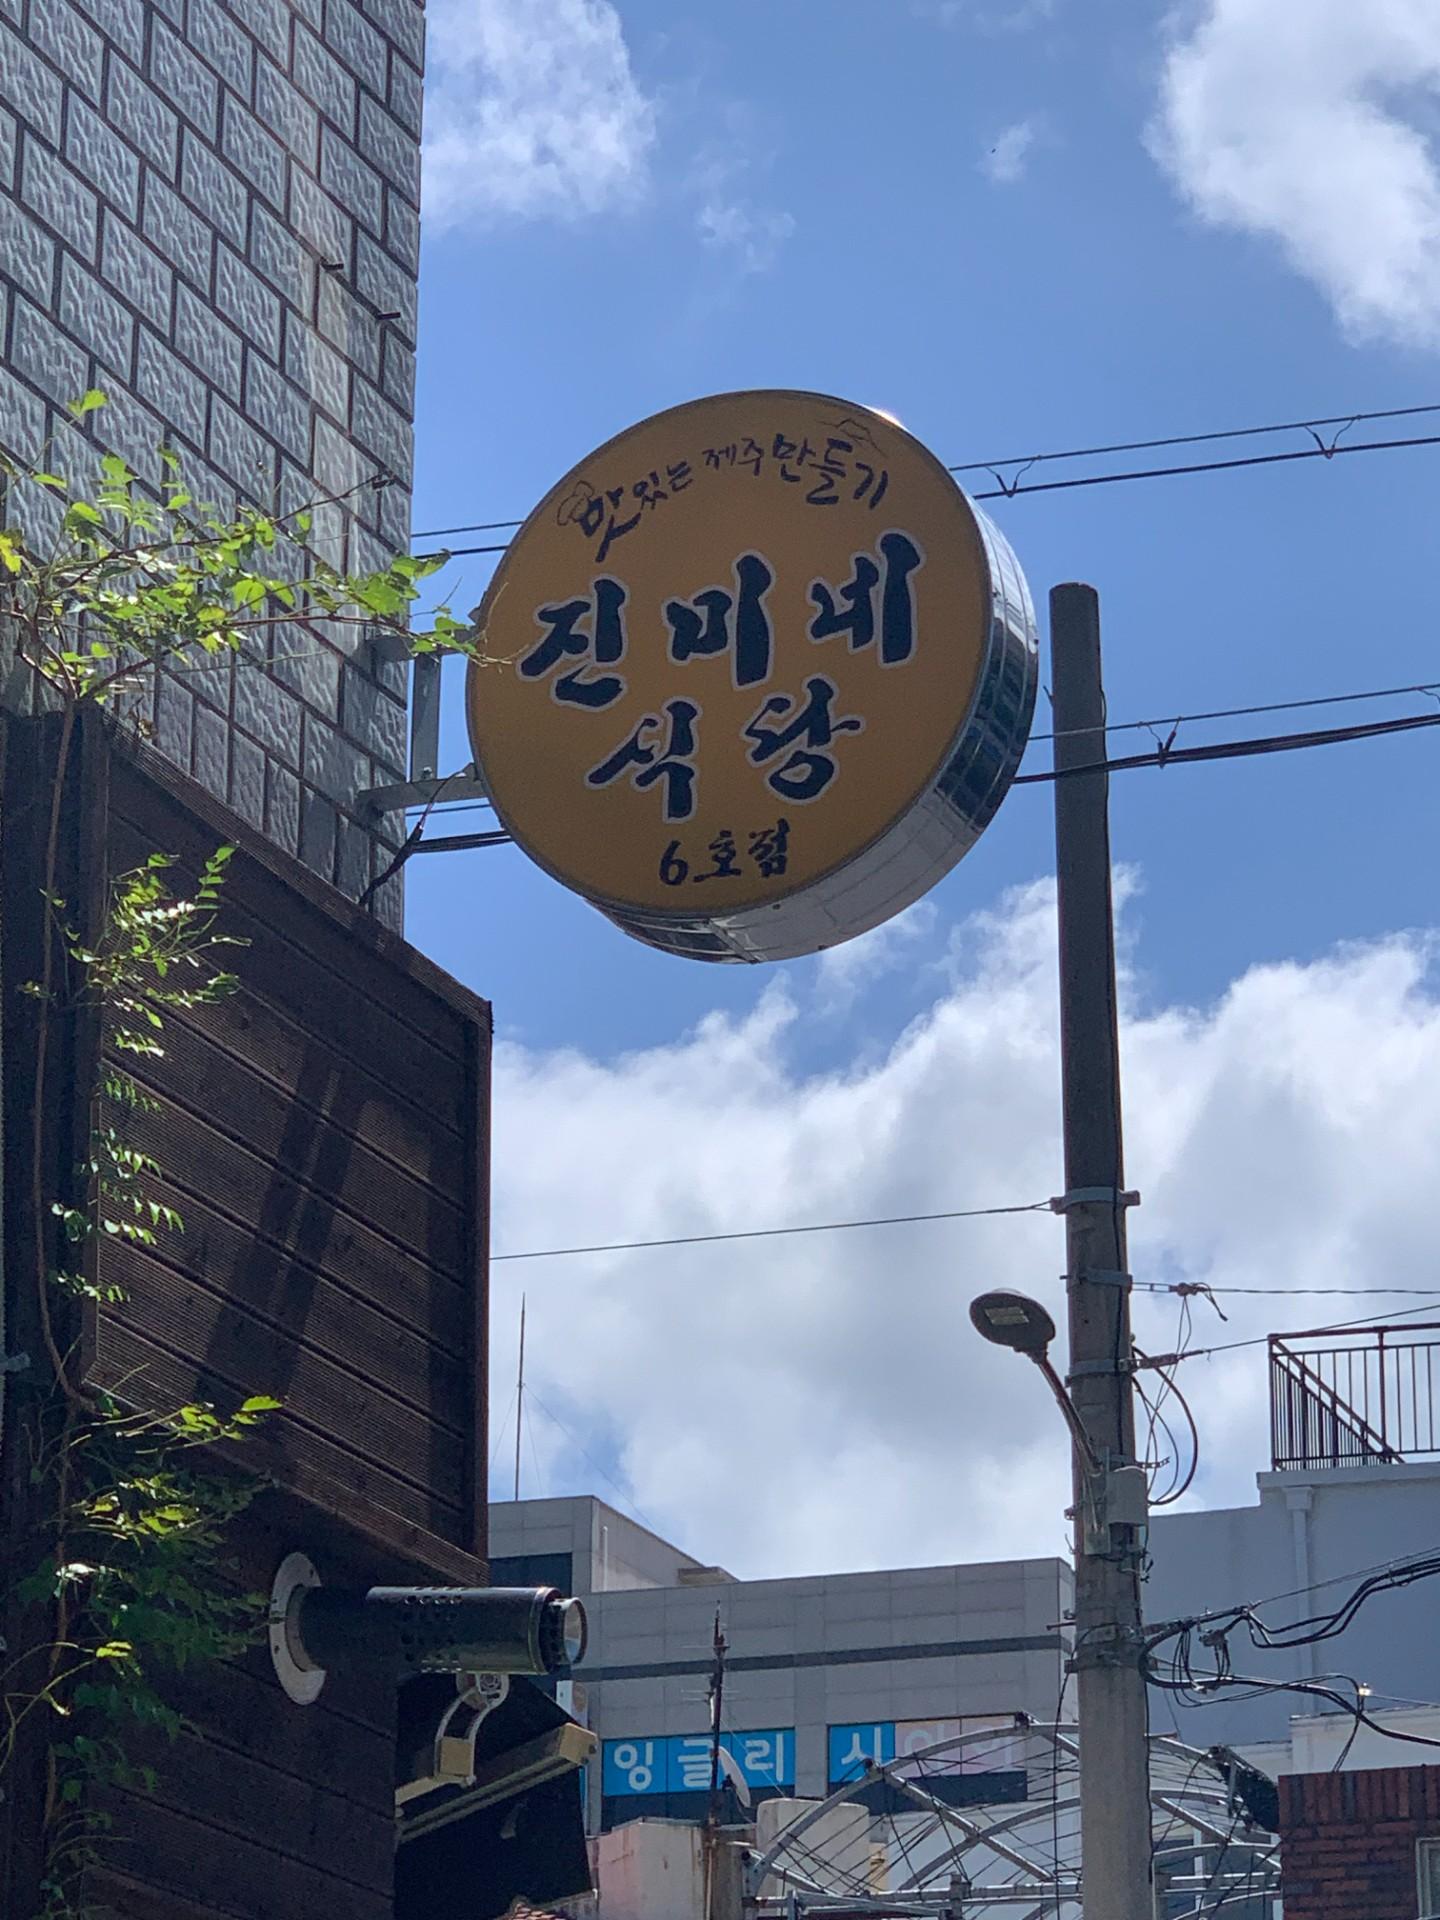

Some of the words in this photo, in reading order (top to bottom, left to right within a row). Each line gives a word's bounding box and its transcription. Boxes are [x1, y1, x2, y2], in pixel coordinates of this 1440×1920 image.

[577, 460, 693, 563] 맛있는
[518, 529, 923, 708] 진미네
[586, 677, 862, 820] 식당
[659, 818, 790, 886] 6호점
